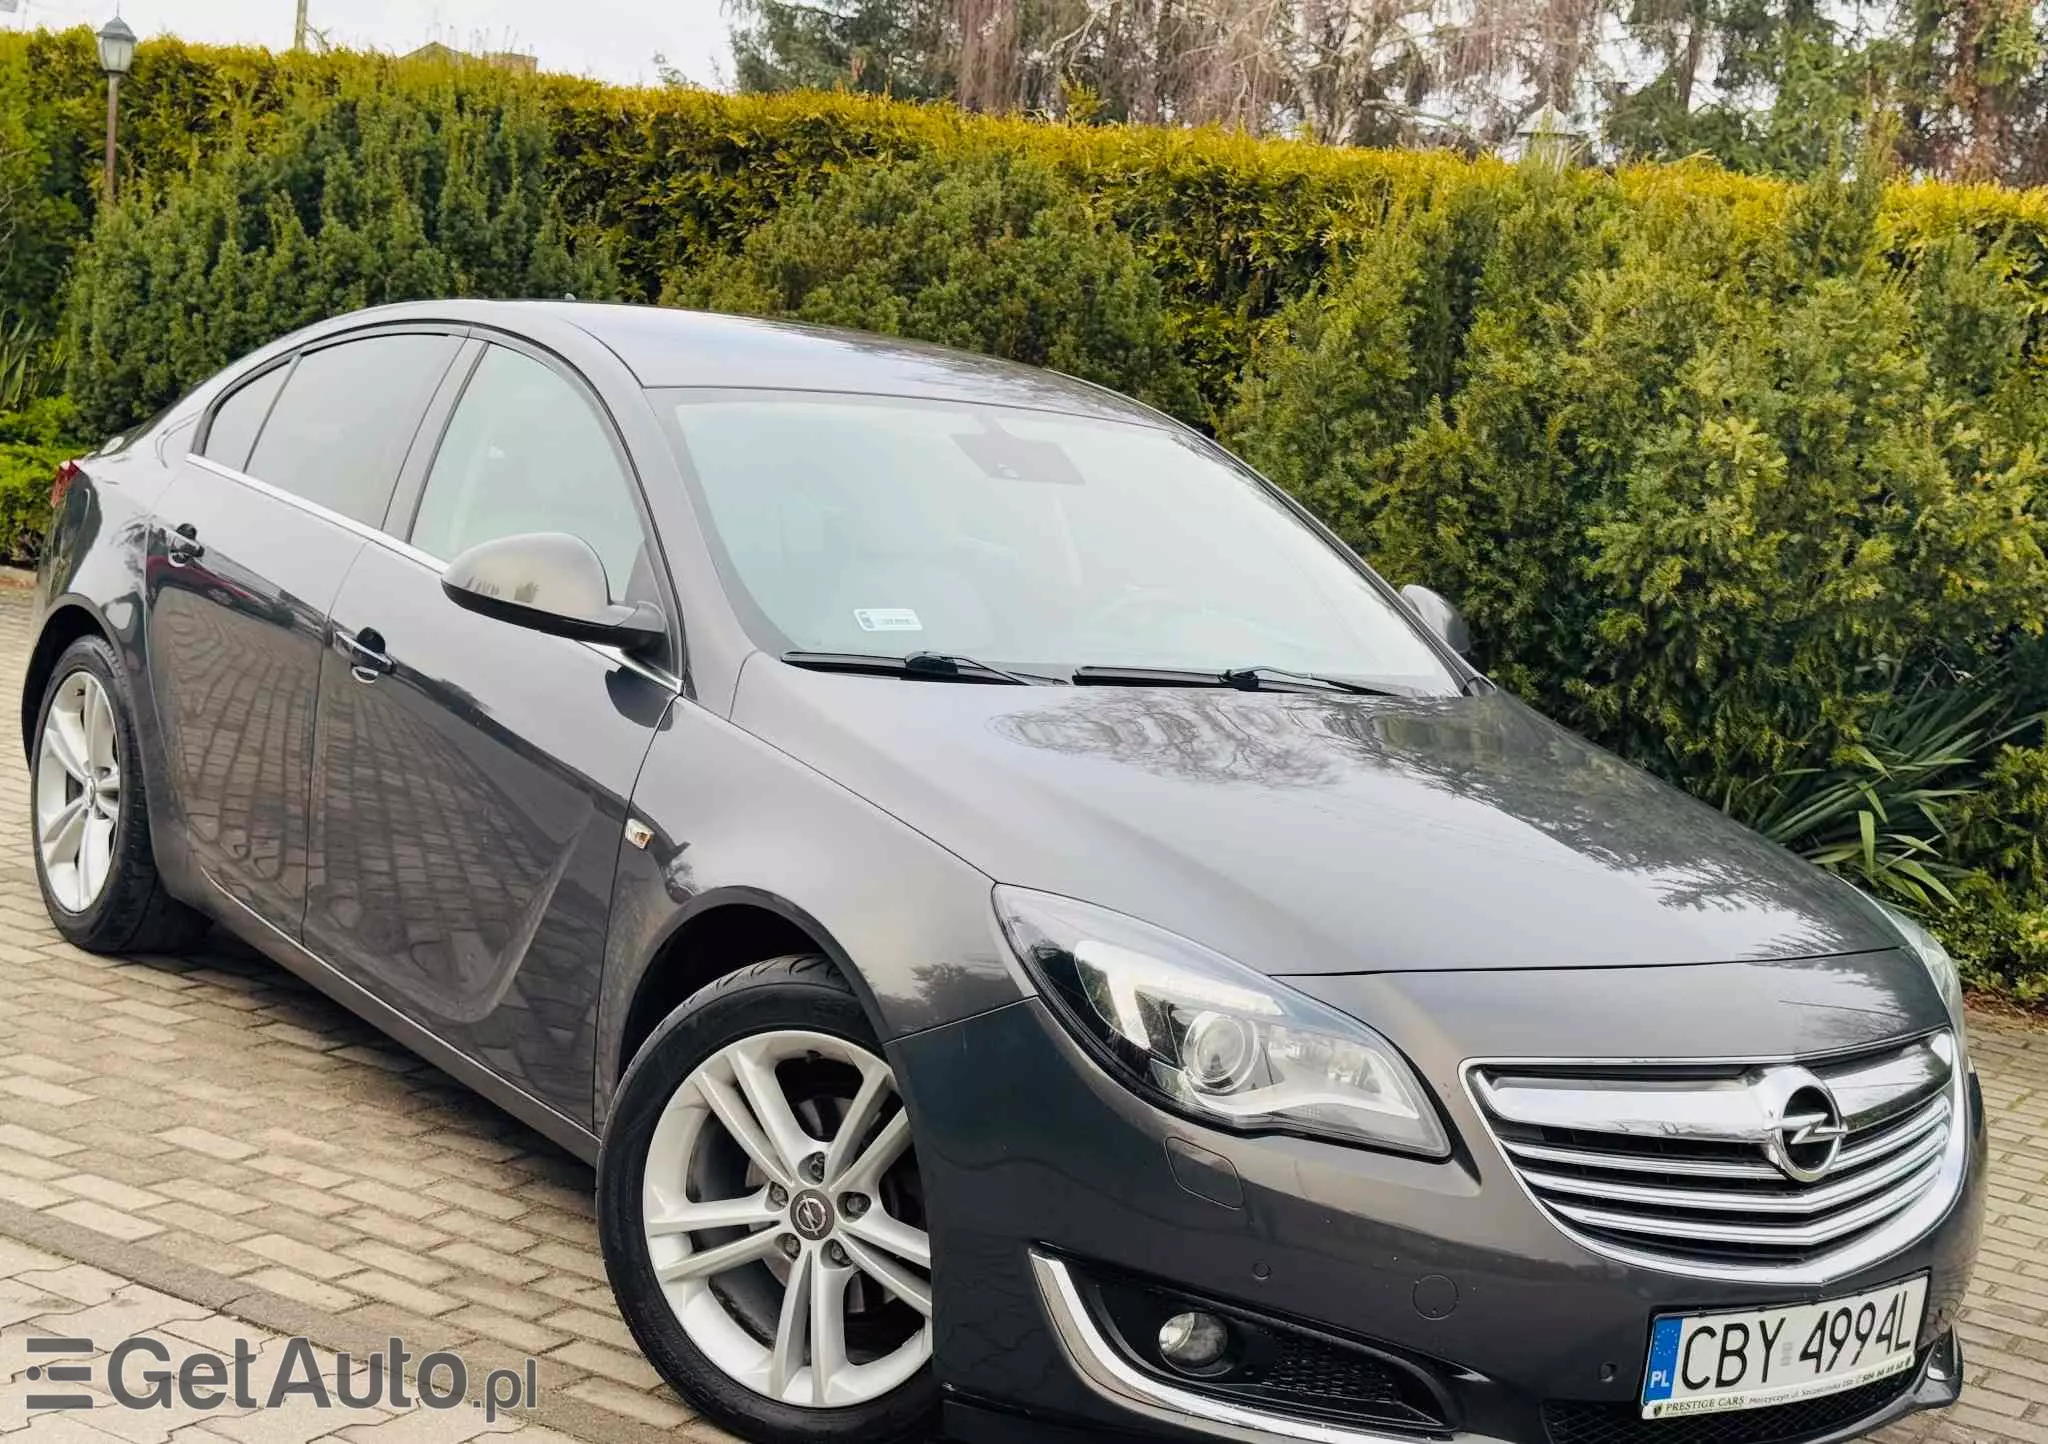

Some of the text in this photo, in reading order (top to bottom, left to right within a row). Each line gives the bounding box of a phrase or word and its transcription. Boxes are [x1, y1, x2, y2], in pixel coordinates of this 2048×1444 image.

[1681, 1290, 1911, 1391] CBY 4994L
[1650, 1370, 1670, 1389] PL
[1665, 1399, 1716, 1412] PRESTIGE
[1718, 1395, 1745, 1406] CARS
